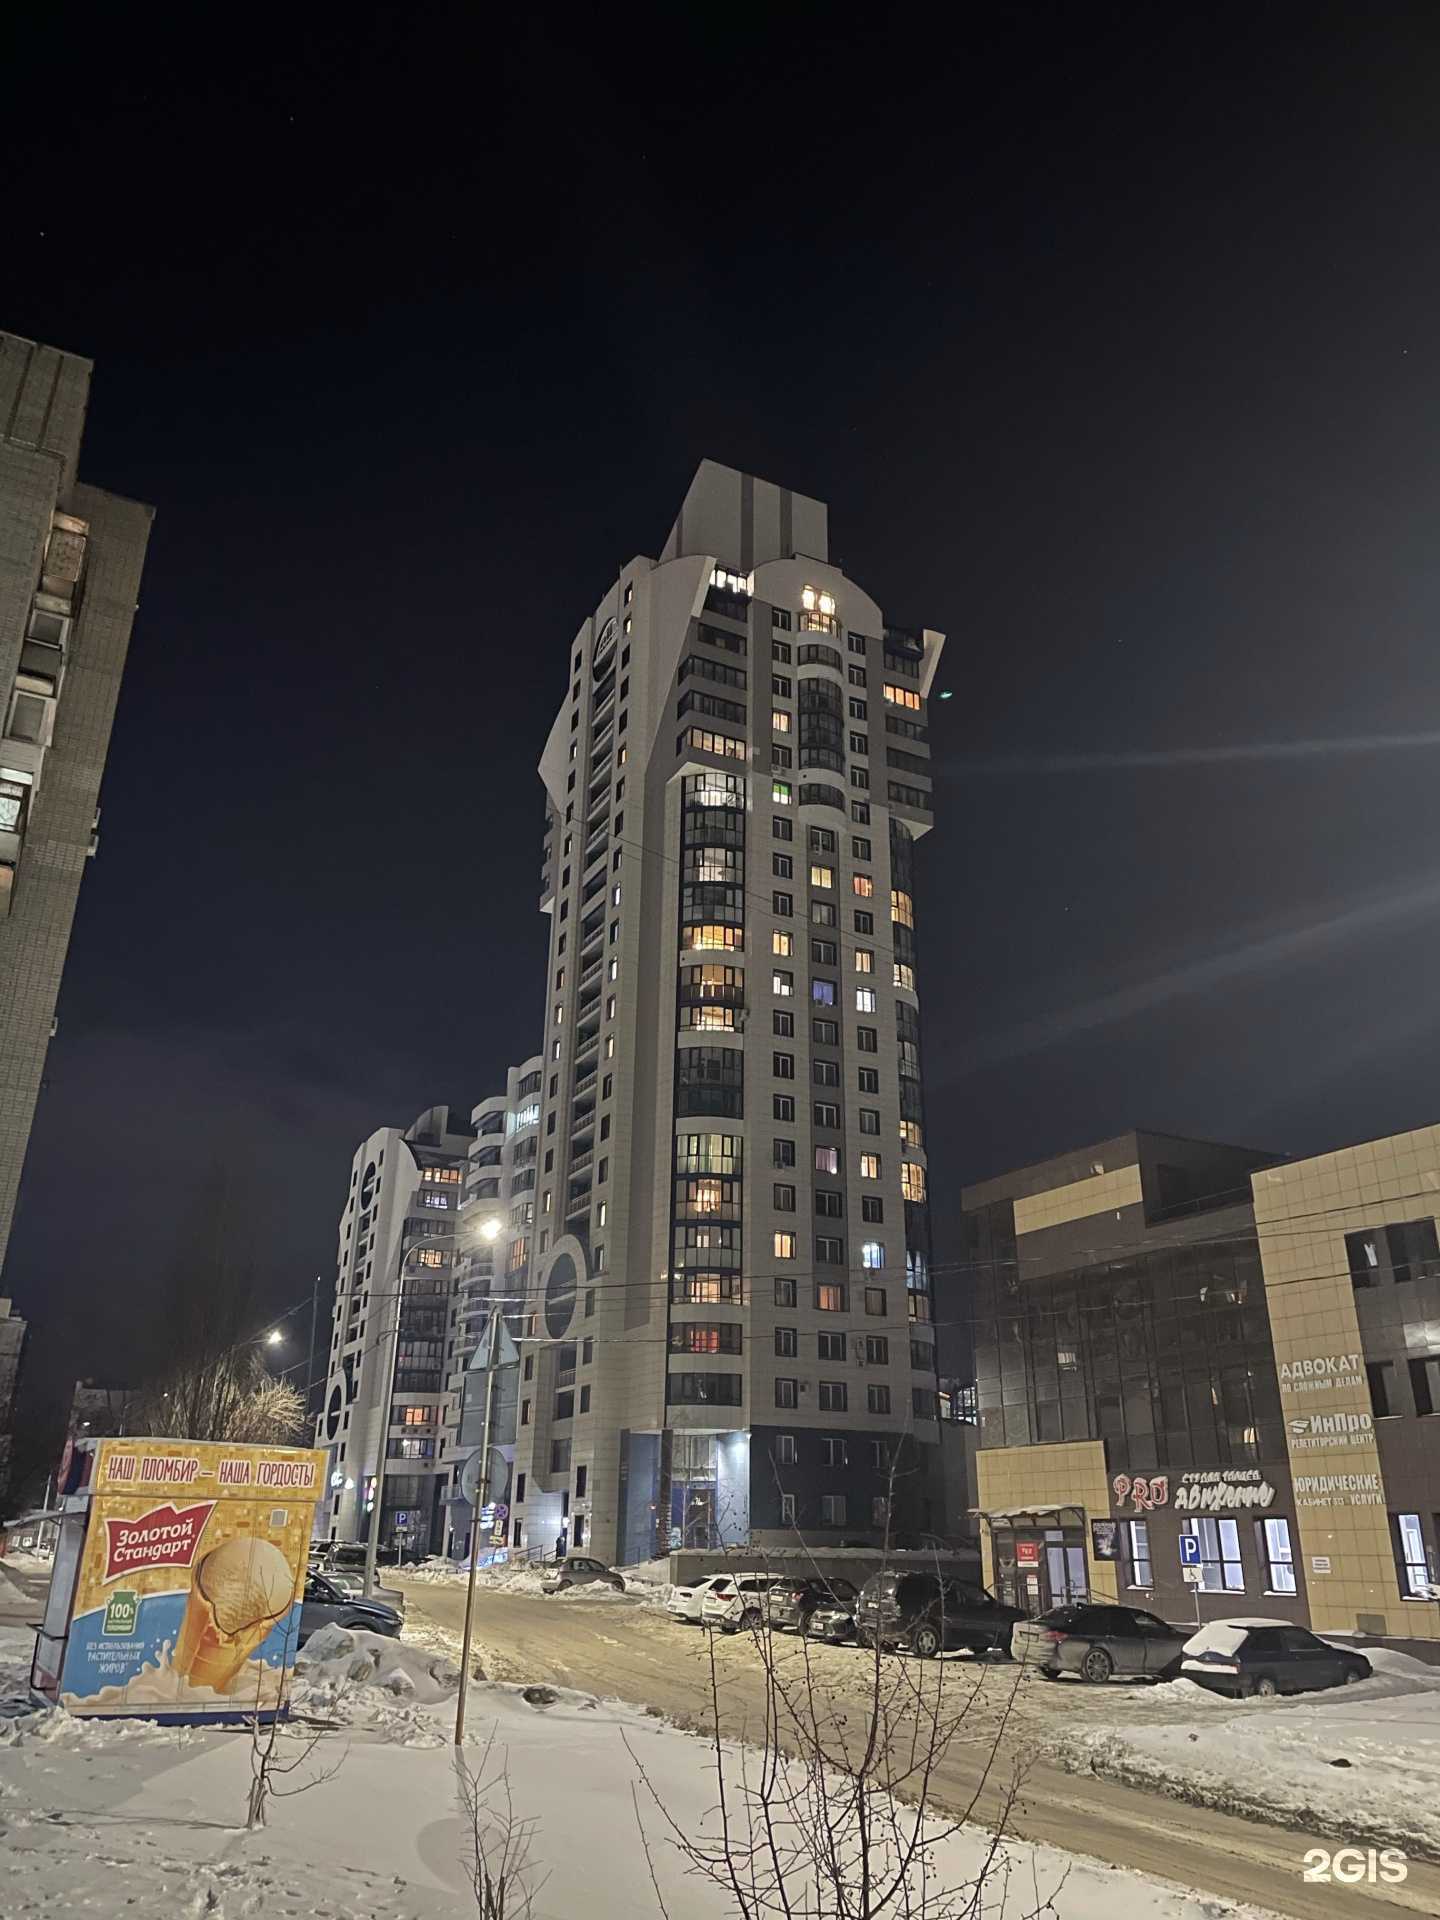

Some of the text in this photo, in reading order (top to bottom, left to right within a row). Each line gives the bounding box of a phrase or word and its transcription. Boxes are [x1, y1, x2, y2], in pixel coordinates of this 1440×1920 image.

[1280, 1354, 1359, 1379] АДВОКАТ
[1282, 1375, 1363, 1393] ПО СЛОЖНЫМ ДЕЛАМ
[1310, 1413, 1372, 1434] ИнПро
[1350, 1432, 1375, 1446] ЦЕНТР
[108, 1457, 135, 1480] НАШ
[141, 1458, 199, 1482] ПЛОМБИР
[219, 1461, 250, 1485] НАША
[257, 1462, 315, 1487] ГОРДОСТЬ!
[1294, 1474, 1379, 1493] ЮРИДИЧЕСКИЕ
[1350, 1493, 1385, 1505] УСЛУГИ
[116, 1519, 194, 1547] Золотой
[113, 1538, 192, 1562] Стандарт
